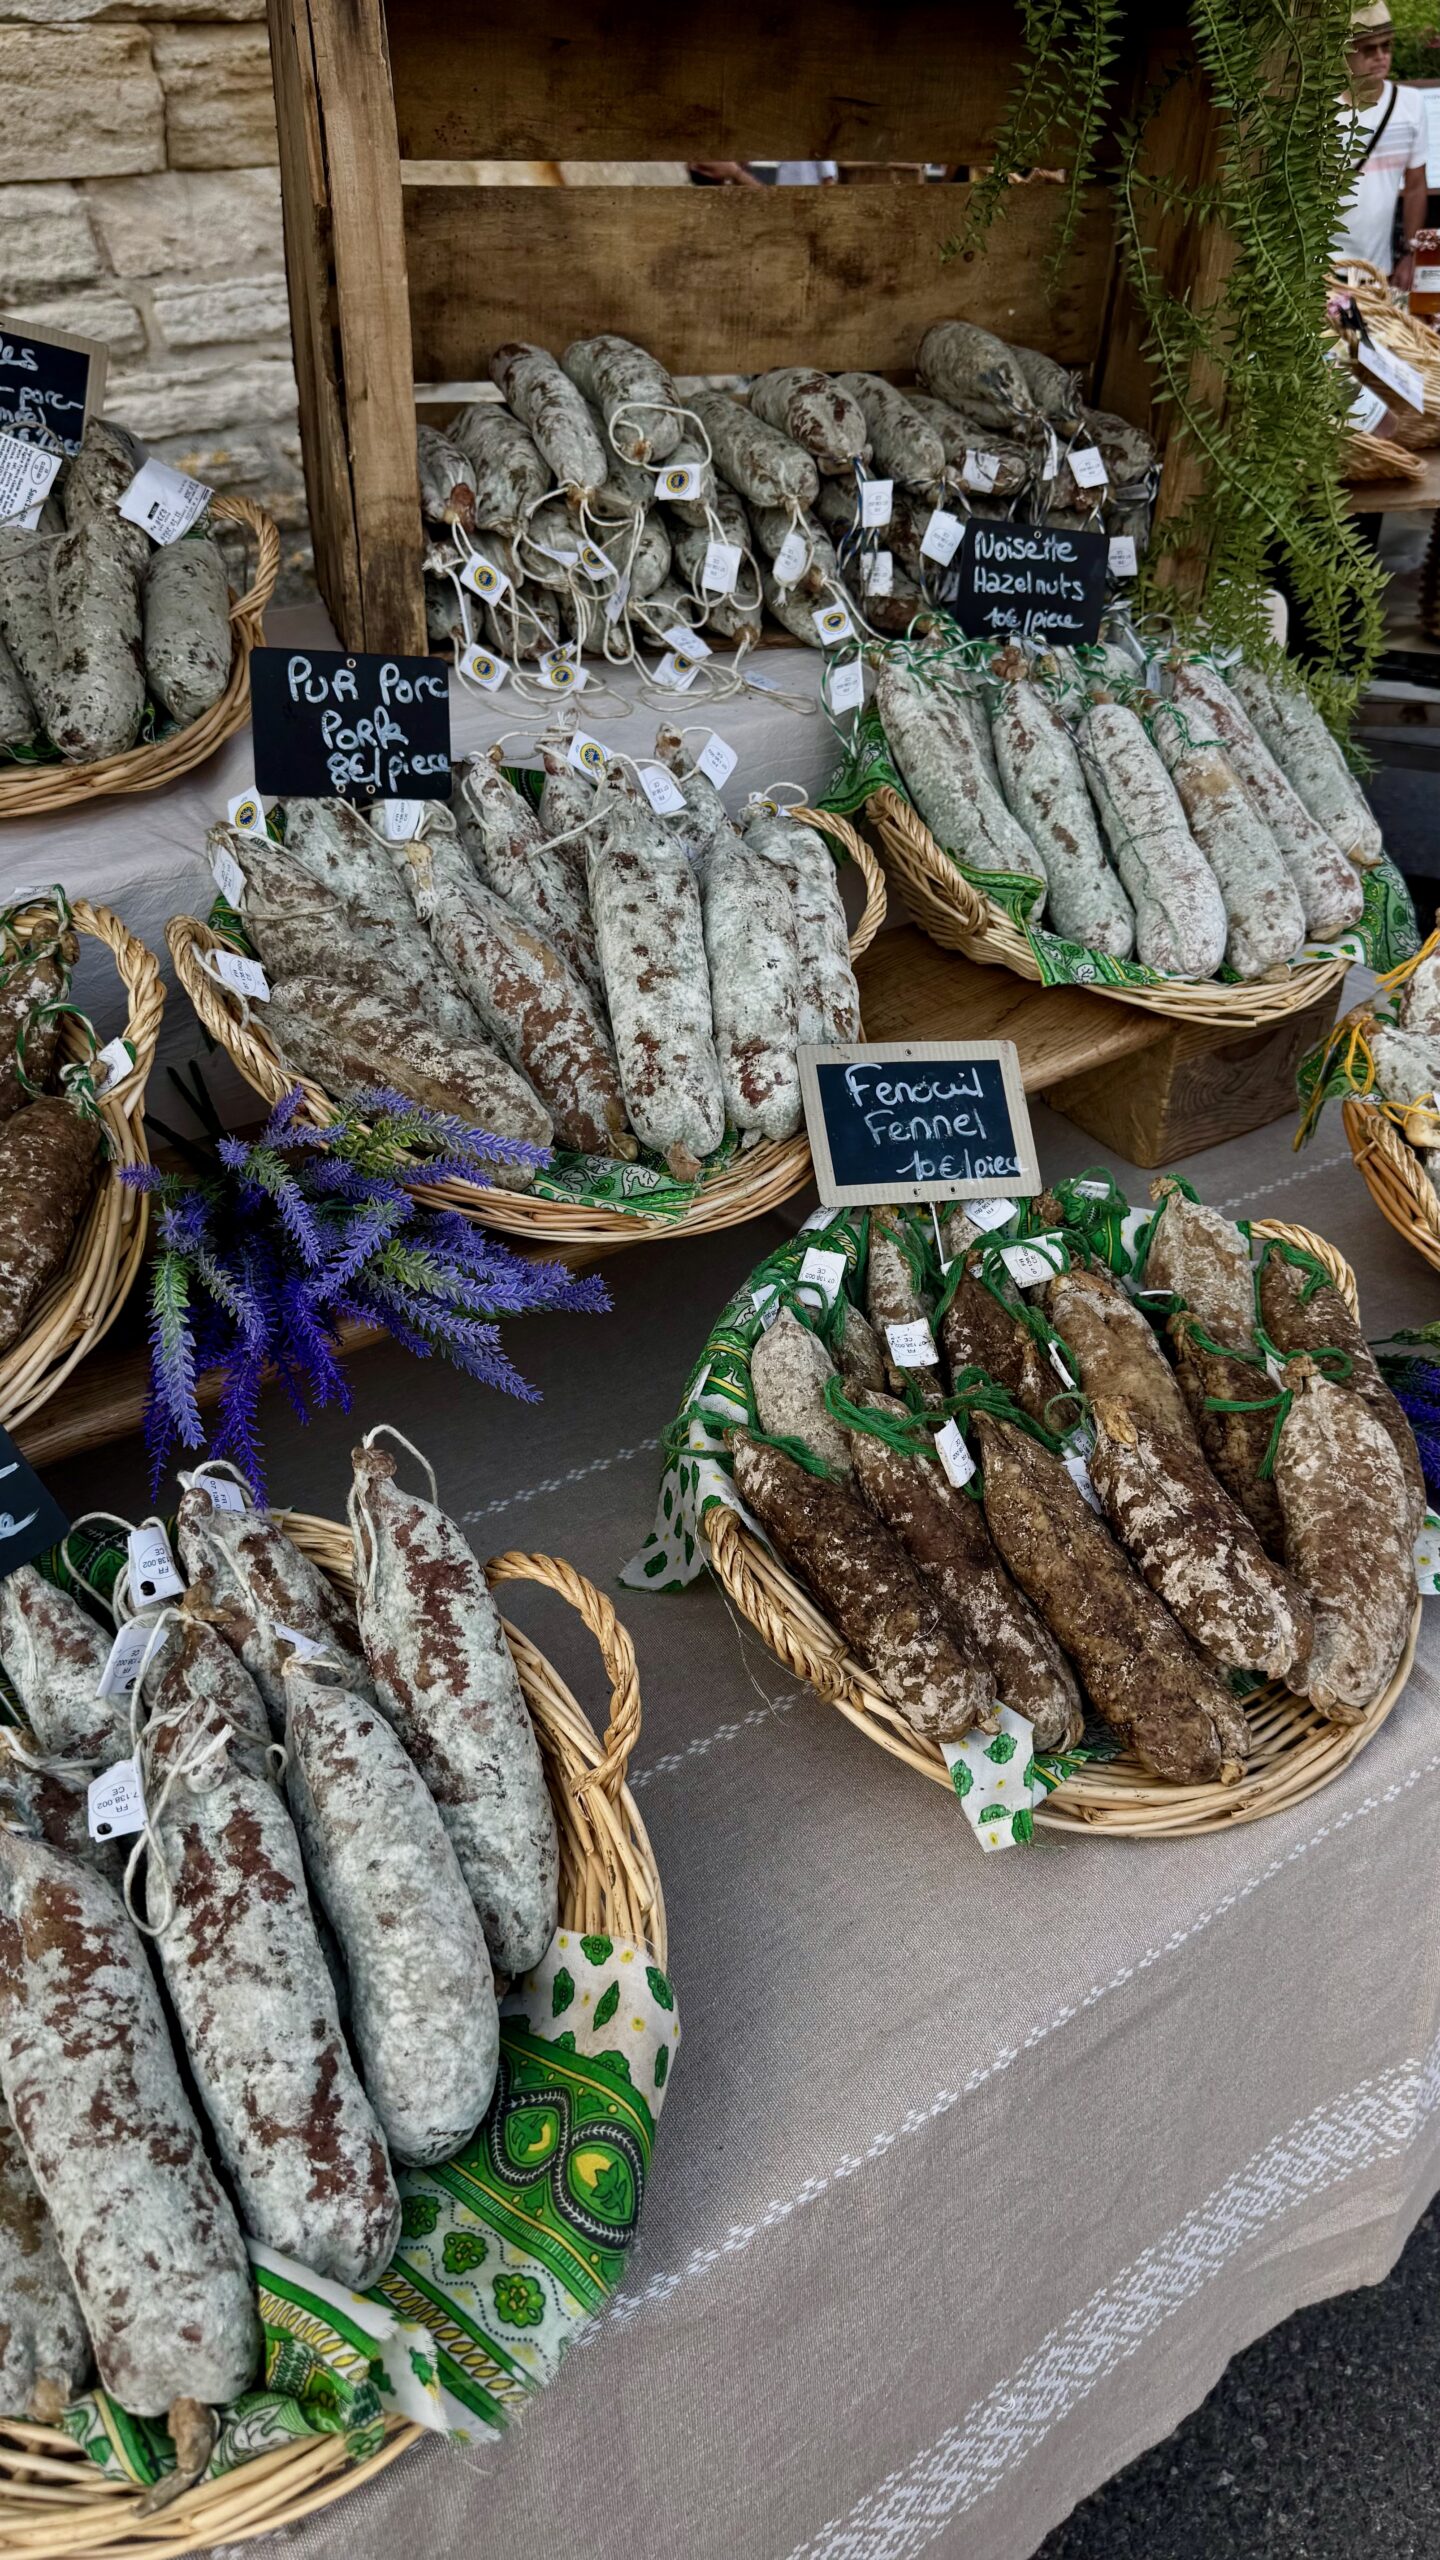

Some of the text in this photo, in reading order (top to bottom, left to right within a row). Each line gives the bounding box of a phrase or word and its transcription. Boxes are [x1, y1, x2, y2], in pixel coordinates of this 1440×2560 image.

[974, 530, 1078, 562] Noisette
[863, 1108, 988, 1146] Fennel
[154, 1548, 165, 1556] CE
[158, 1565, 169, 1575] FR
[112, 1786, 125, 1796] CE
[97, 1791, 138, 1810] 7.138.002
[115, 1803, 129, 1813] FR
